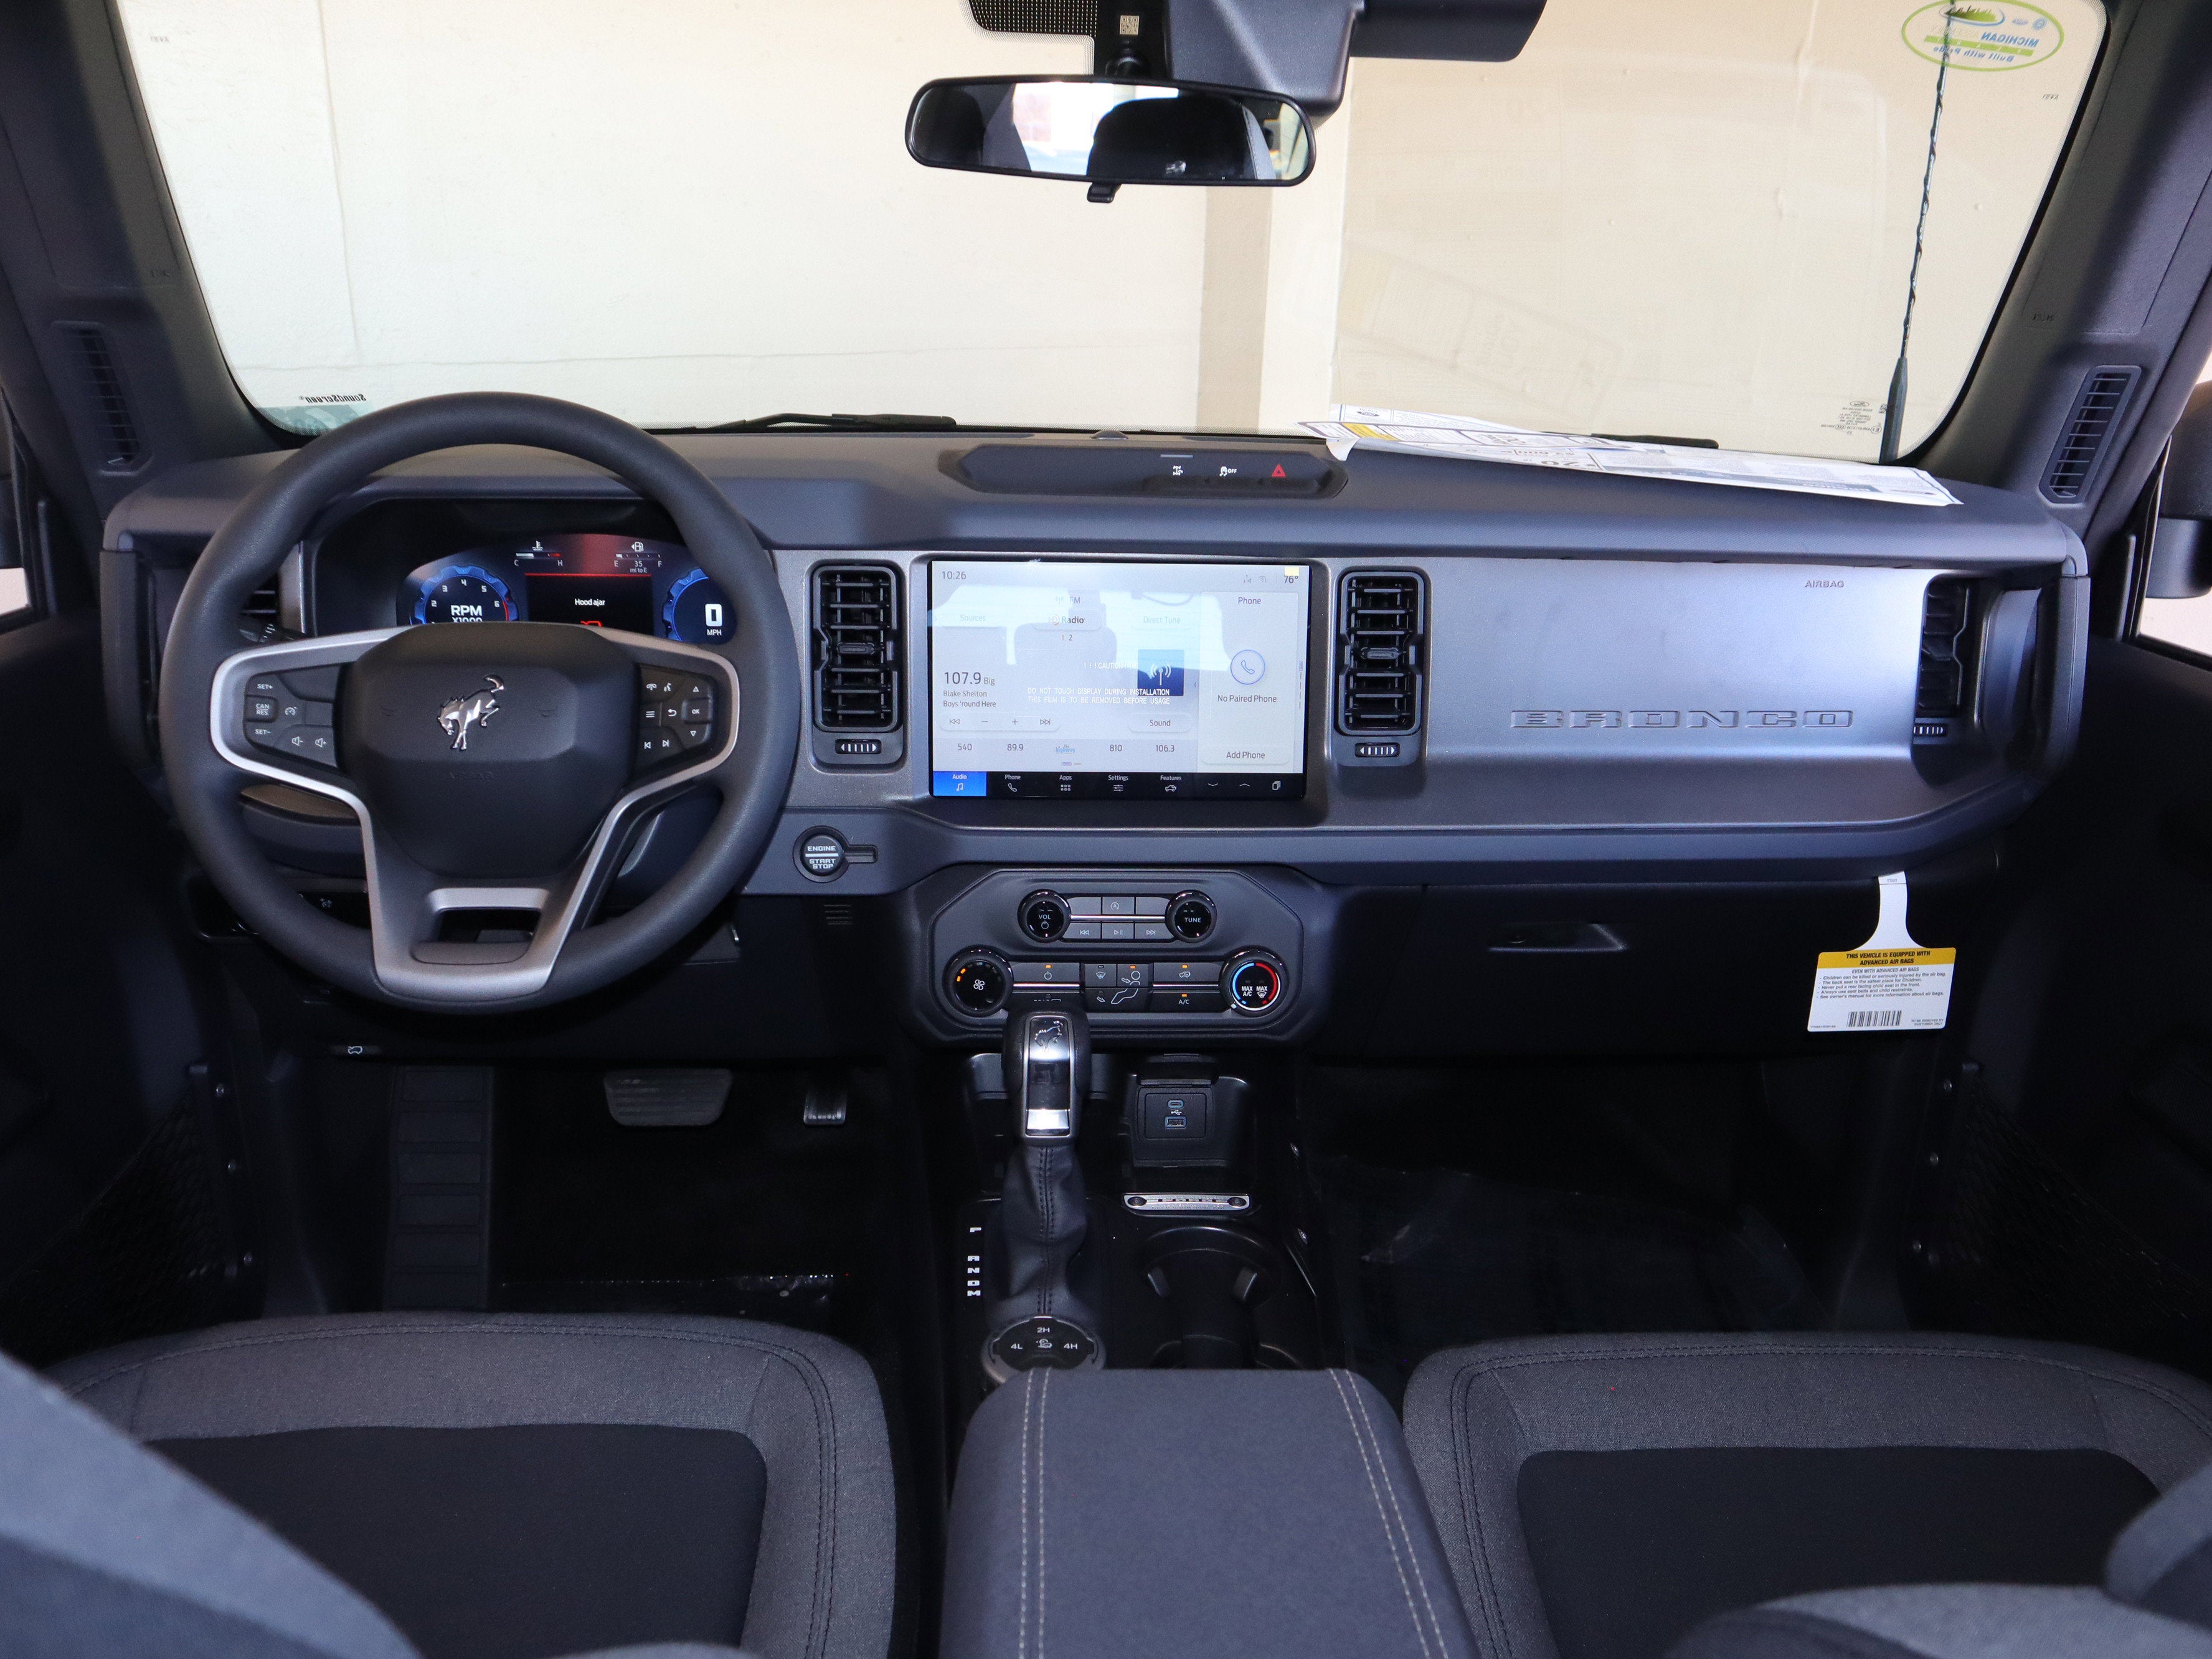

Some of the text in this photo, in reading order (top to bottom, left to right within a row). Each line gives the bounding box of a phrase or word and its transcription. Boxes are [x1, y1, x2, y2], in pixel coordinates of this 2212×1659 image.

[942, 571, 967, 580] 10:26
[1069, 596, 1080, 604] FM
[1238, 597, 1262, 605] Phone
[451, 605, 482, 616] RPM
[705, 603, 722, 626] 0
[944, 672, 995, 686] 107.9 Big
[1229, 694, 1252, 702] Paired
[943, 701, 958, 709] Boys
[1510, 710, 1854, 729] BRONCO
[957, 743, 973, 751] 540
[1155, 744, 1175, 752] 106.3
[1242, 751, 1265, 759] Phone
